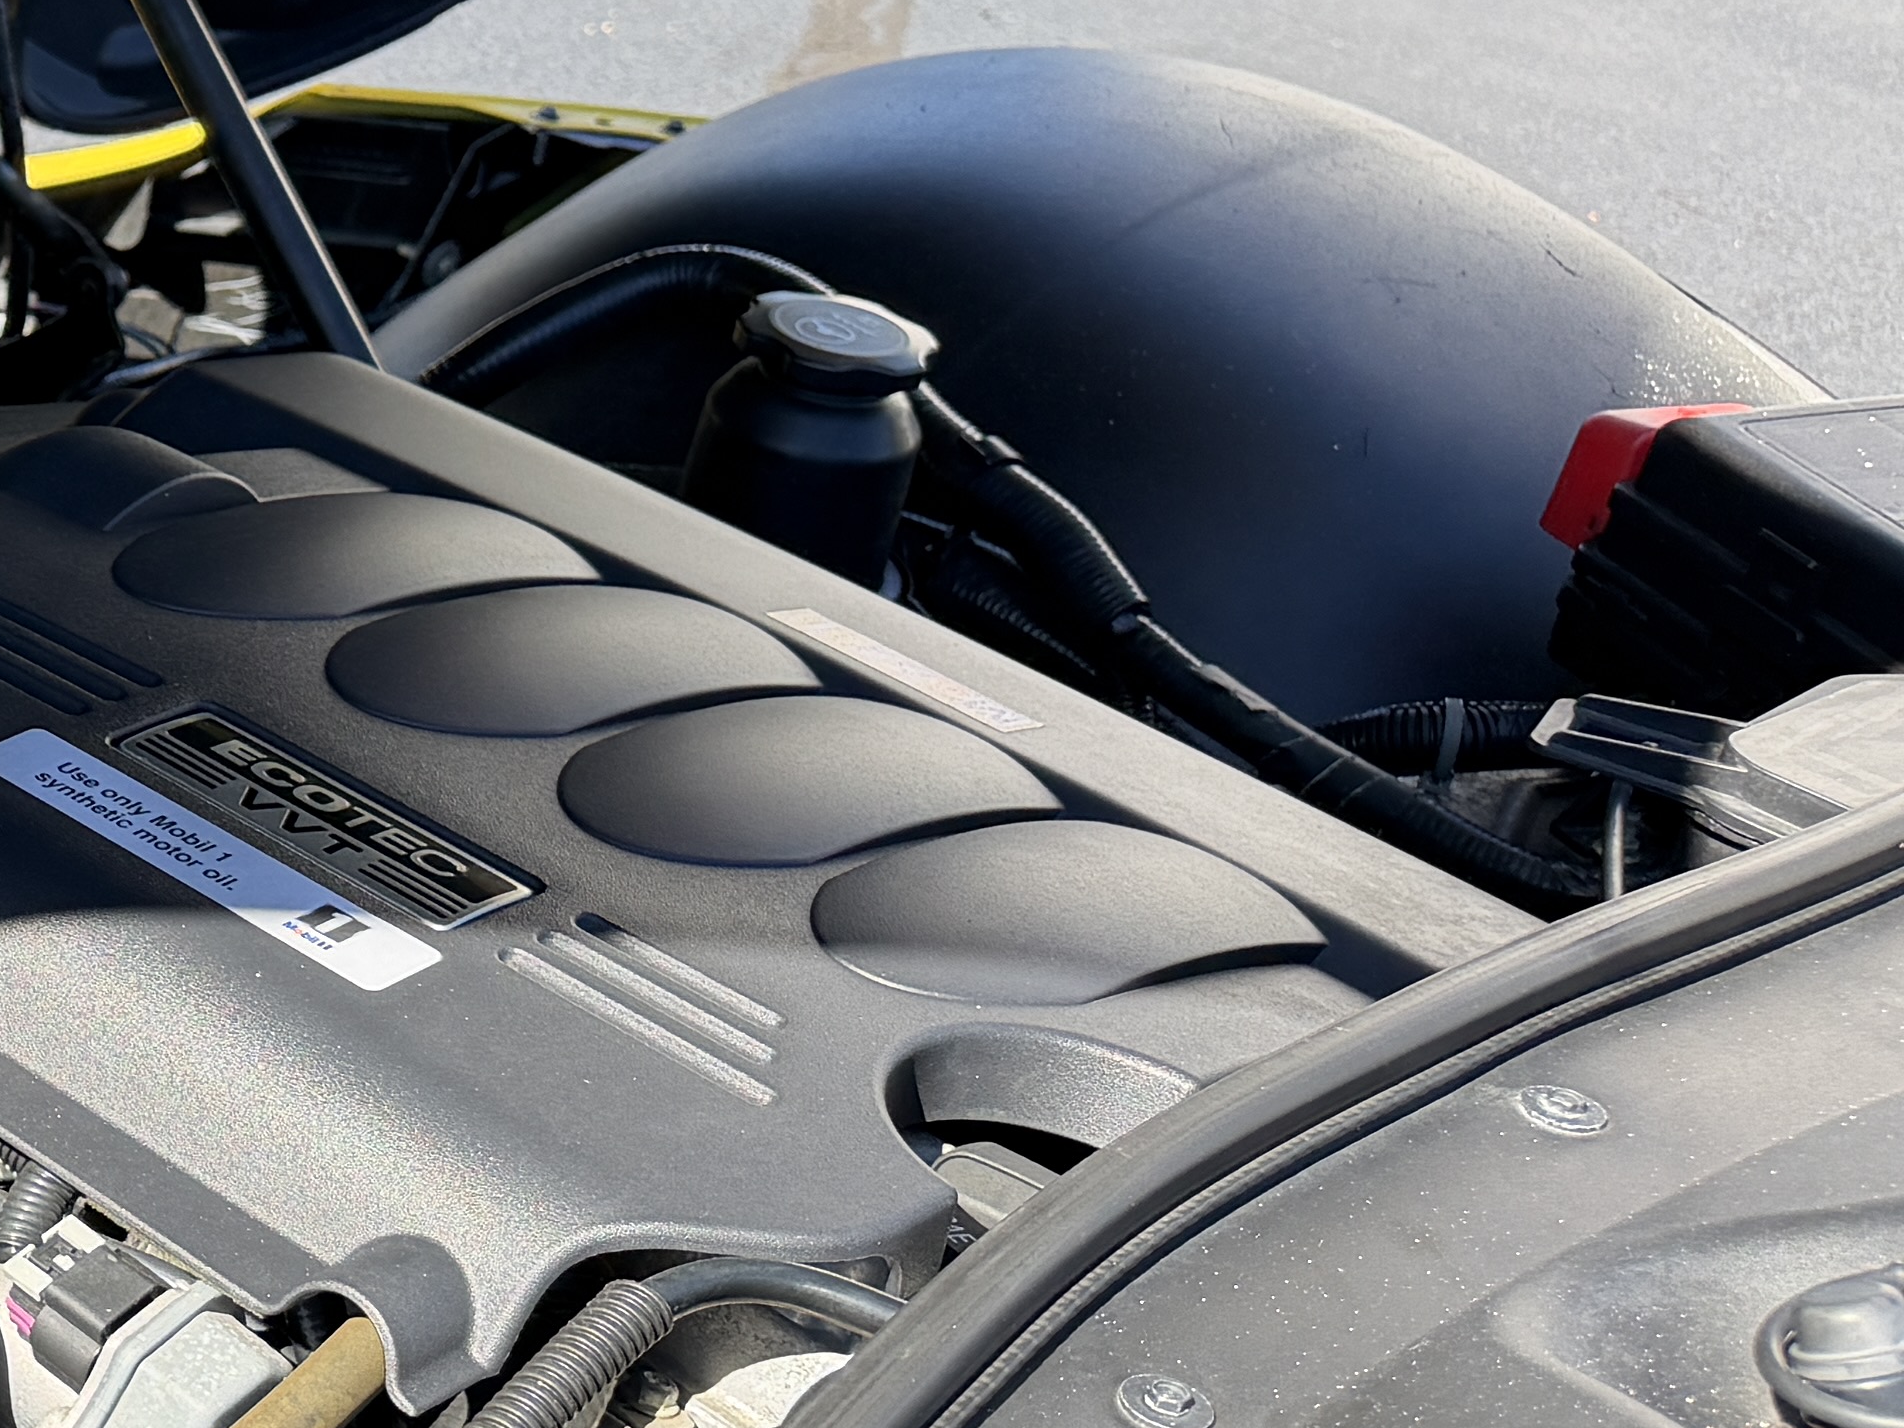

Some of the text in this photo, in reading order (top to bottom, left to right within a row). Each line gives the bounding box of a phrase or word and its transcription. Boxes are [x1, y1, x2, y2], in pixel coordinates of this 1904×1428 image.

[34, 771, 238, 891] synthetic motor oil.
[58, 761, 233, 863] Use only Mobil 1
[211, 738, 468, 878] ECOTEC
[238, 786, 365, 856] VVT
[314, 912, 353, 935] 1
